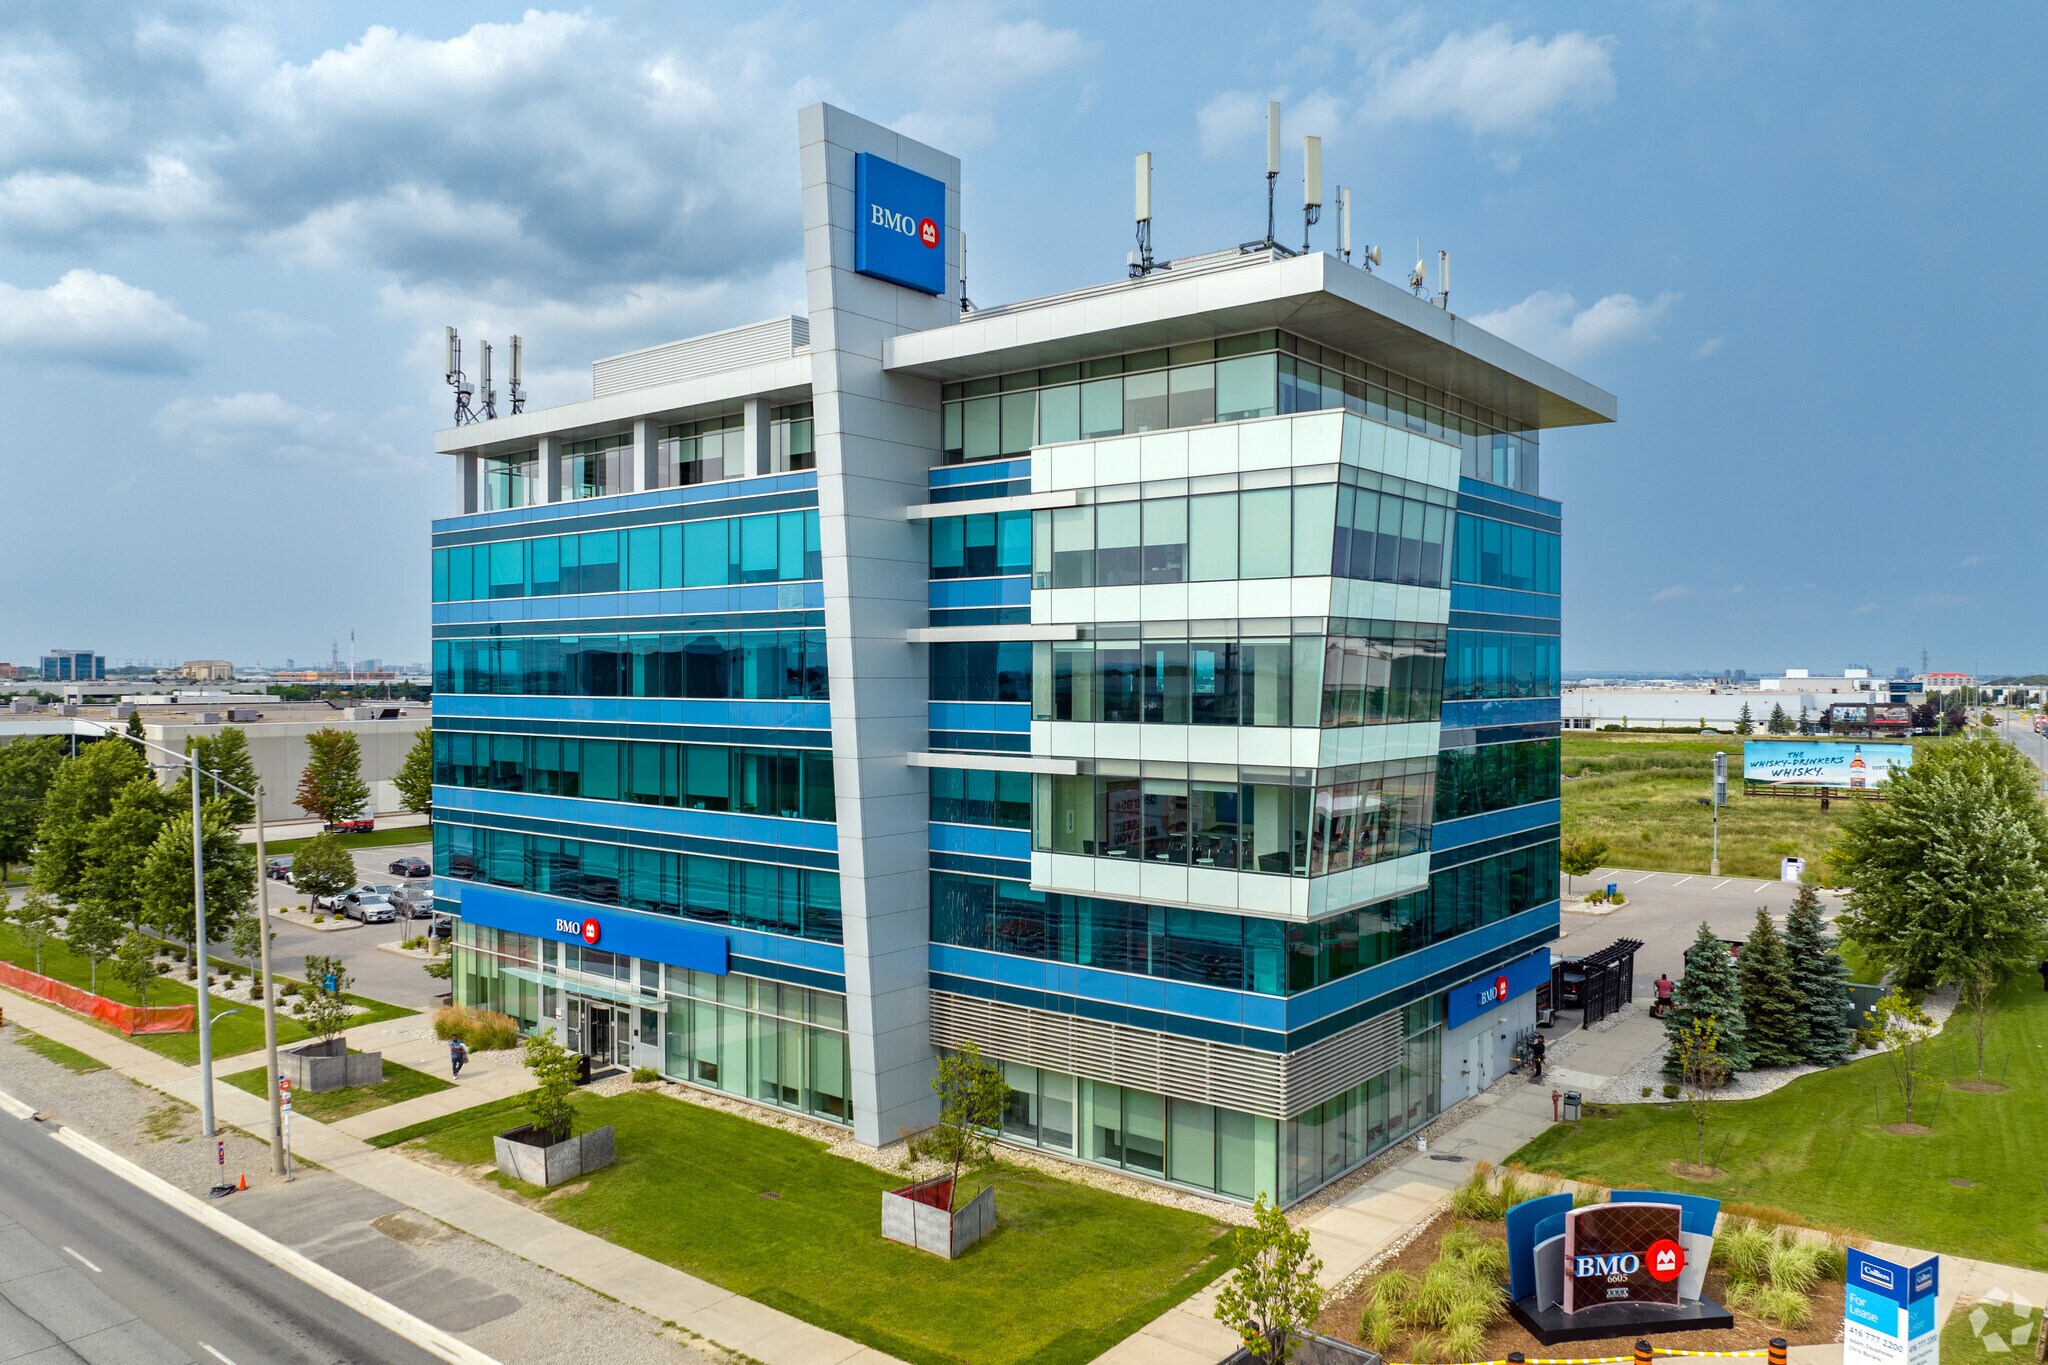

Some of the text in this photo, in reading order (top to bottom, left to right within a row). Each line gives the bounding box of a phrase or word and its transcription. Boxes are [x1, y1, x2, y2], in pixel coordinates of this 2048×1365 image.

[870, 203, 916, 237] BMO
[1750, 756, 1844, 768] WHISKY-DRINKER'S
[1787, 751, 1804, 759] THE
[1771, 767, 1824, 778] WHISKY.
[556, 918, 580, 935] BMO
[1481, 986, 1498, 1005] BMO
[1574, 1252, 1640, 1278] BMO
[1607, 1273, 1628, 1284] 6605
[1864, 1266, 1890, 1281] Colliers
[1849, 1293, 1867, 1307] For
[1849, 1303, 1879, 1324] Lease
[1848, 1326, 1904, 1353] 416 777 2200
